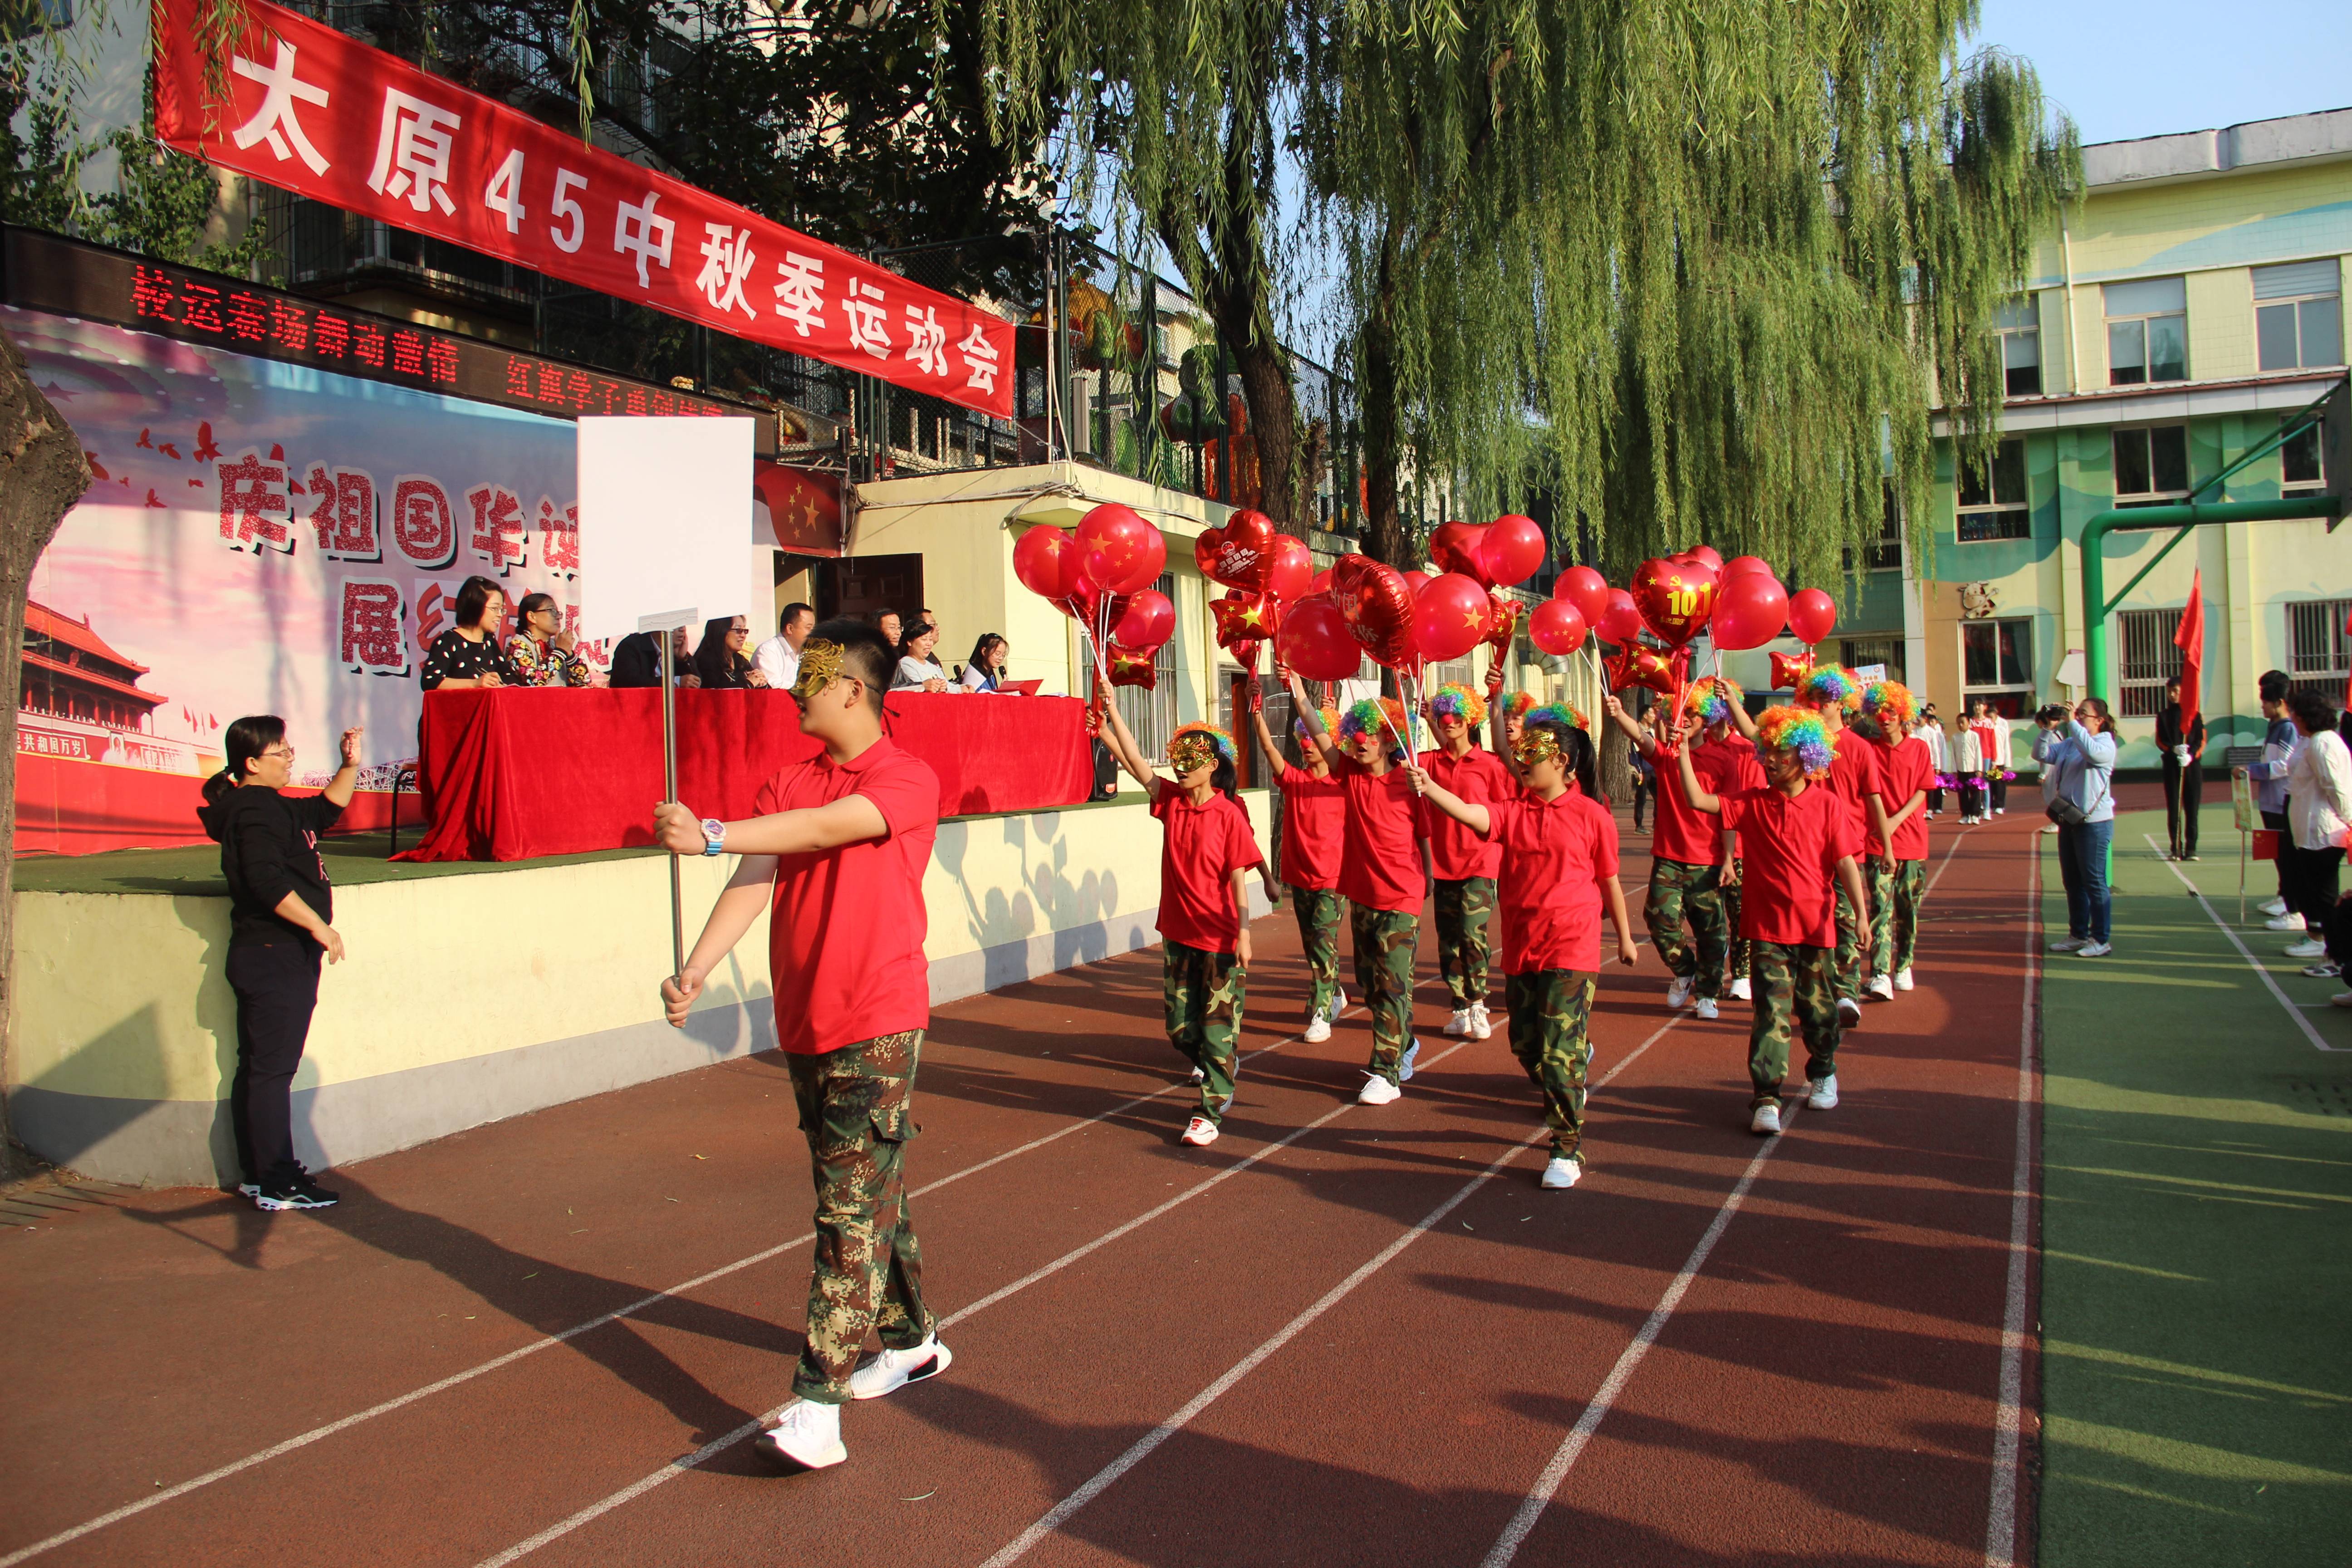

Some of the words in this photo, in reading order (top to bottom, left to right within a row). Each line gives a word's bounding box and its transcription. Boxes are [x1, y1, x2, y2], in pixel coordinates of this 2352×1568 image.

[232, 39, 998, 395] 太原45中秋季运动会
[1667, 582, 1710, 616] 10.1
